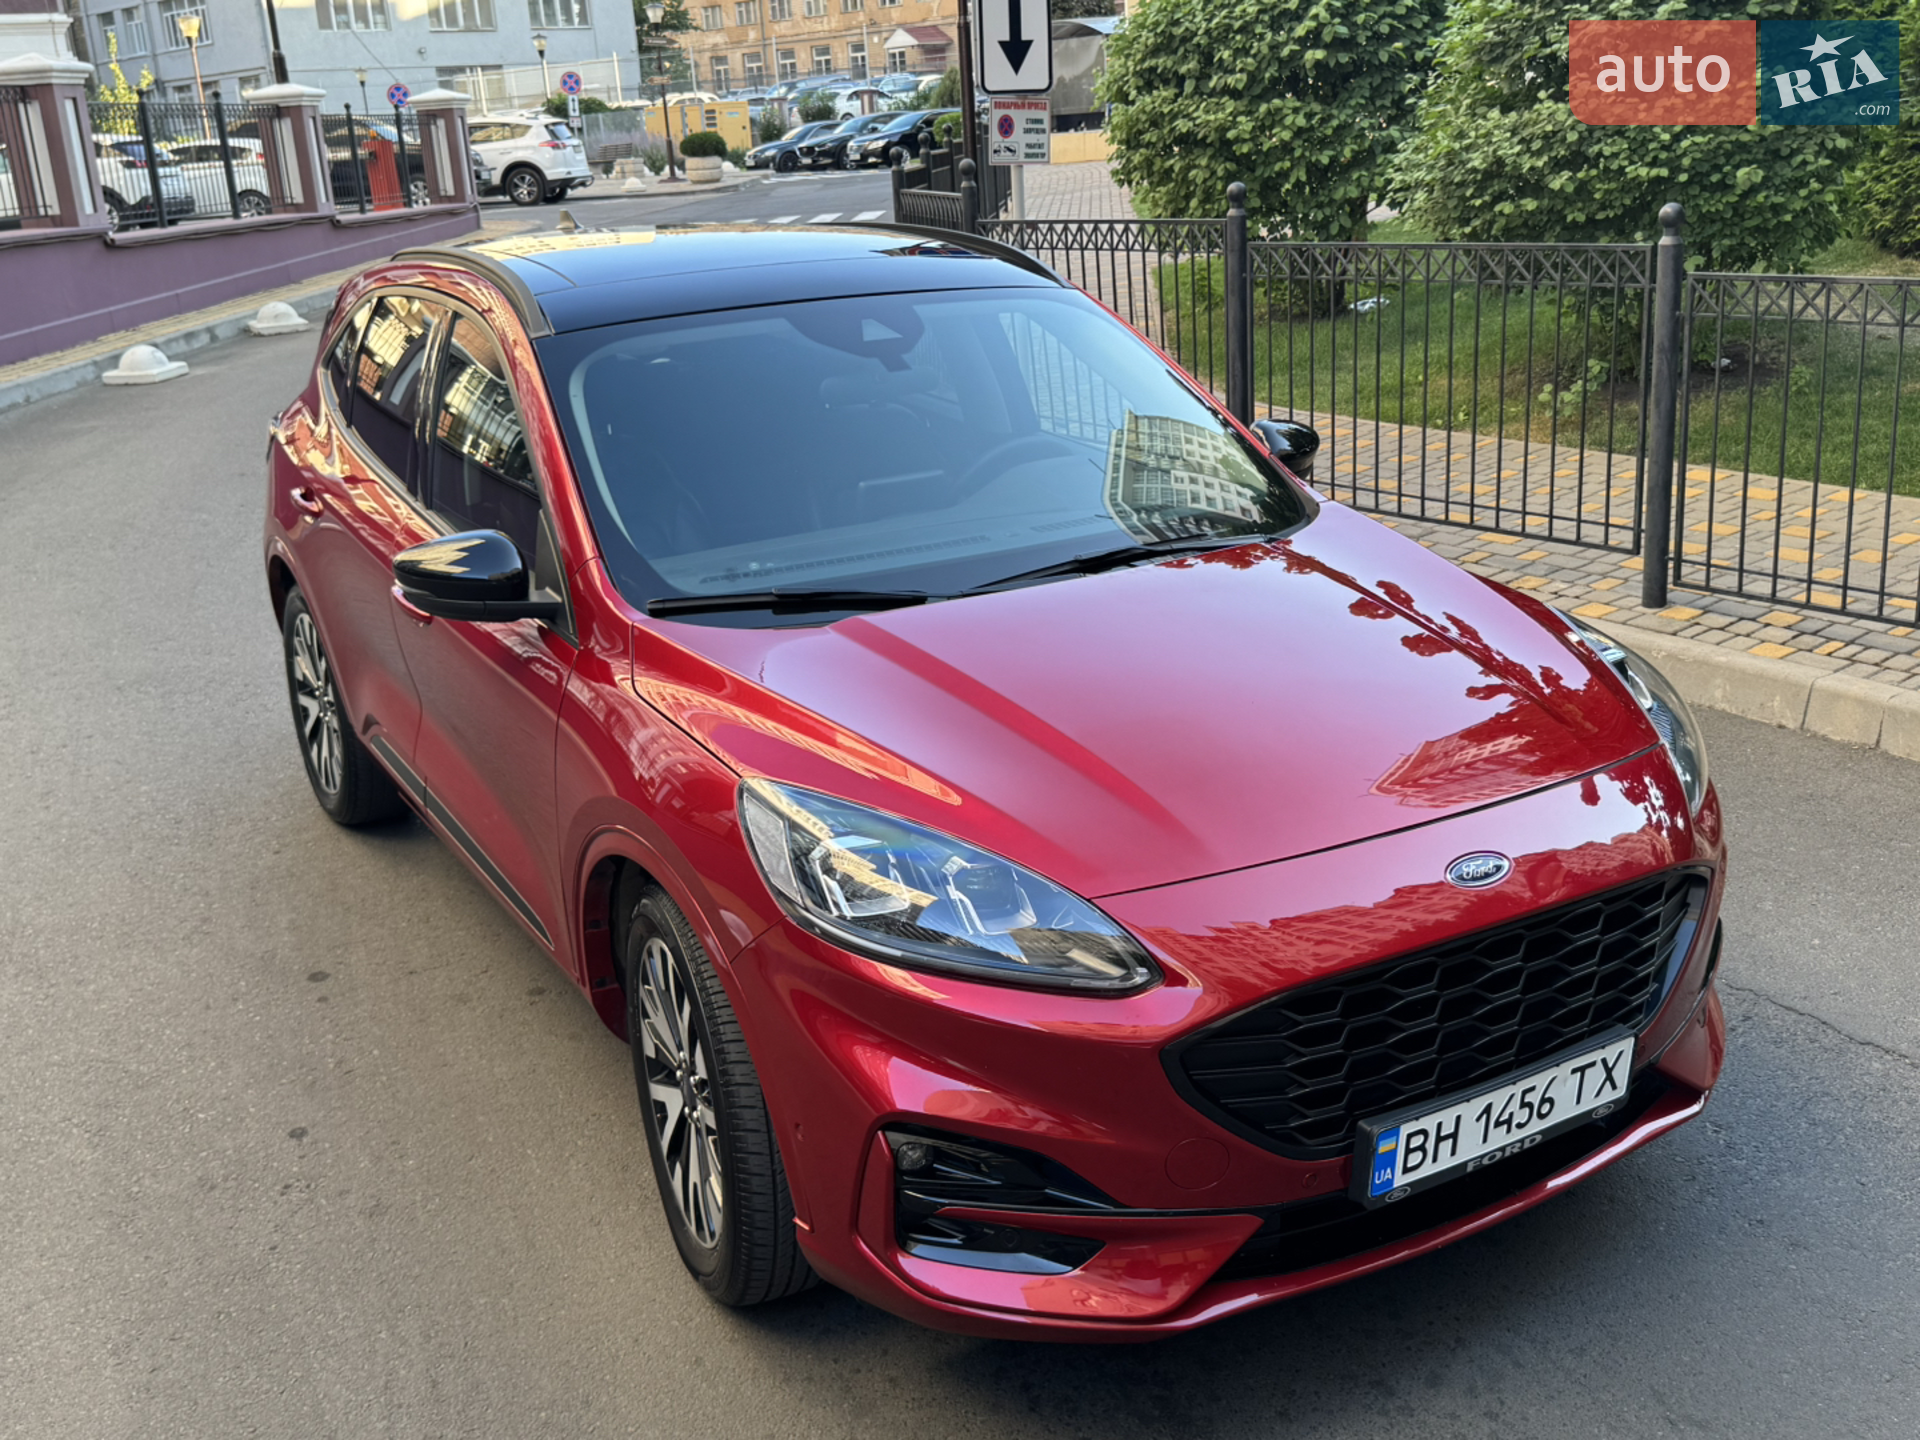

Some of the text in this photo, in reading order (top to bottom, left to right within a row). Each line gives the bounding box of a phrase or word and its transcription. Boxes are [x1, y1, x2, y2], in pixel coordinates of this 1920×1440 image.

[1462, 859, 1497, 879] Ford
[1401, 1049, 1625, 1176] BH 1456 TX
[1466, 1134, 1543, 1173] FORD
[1375, 1167, 1393, 1184] UA
